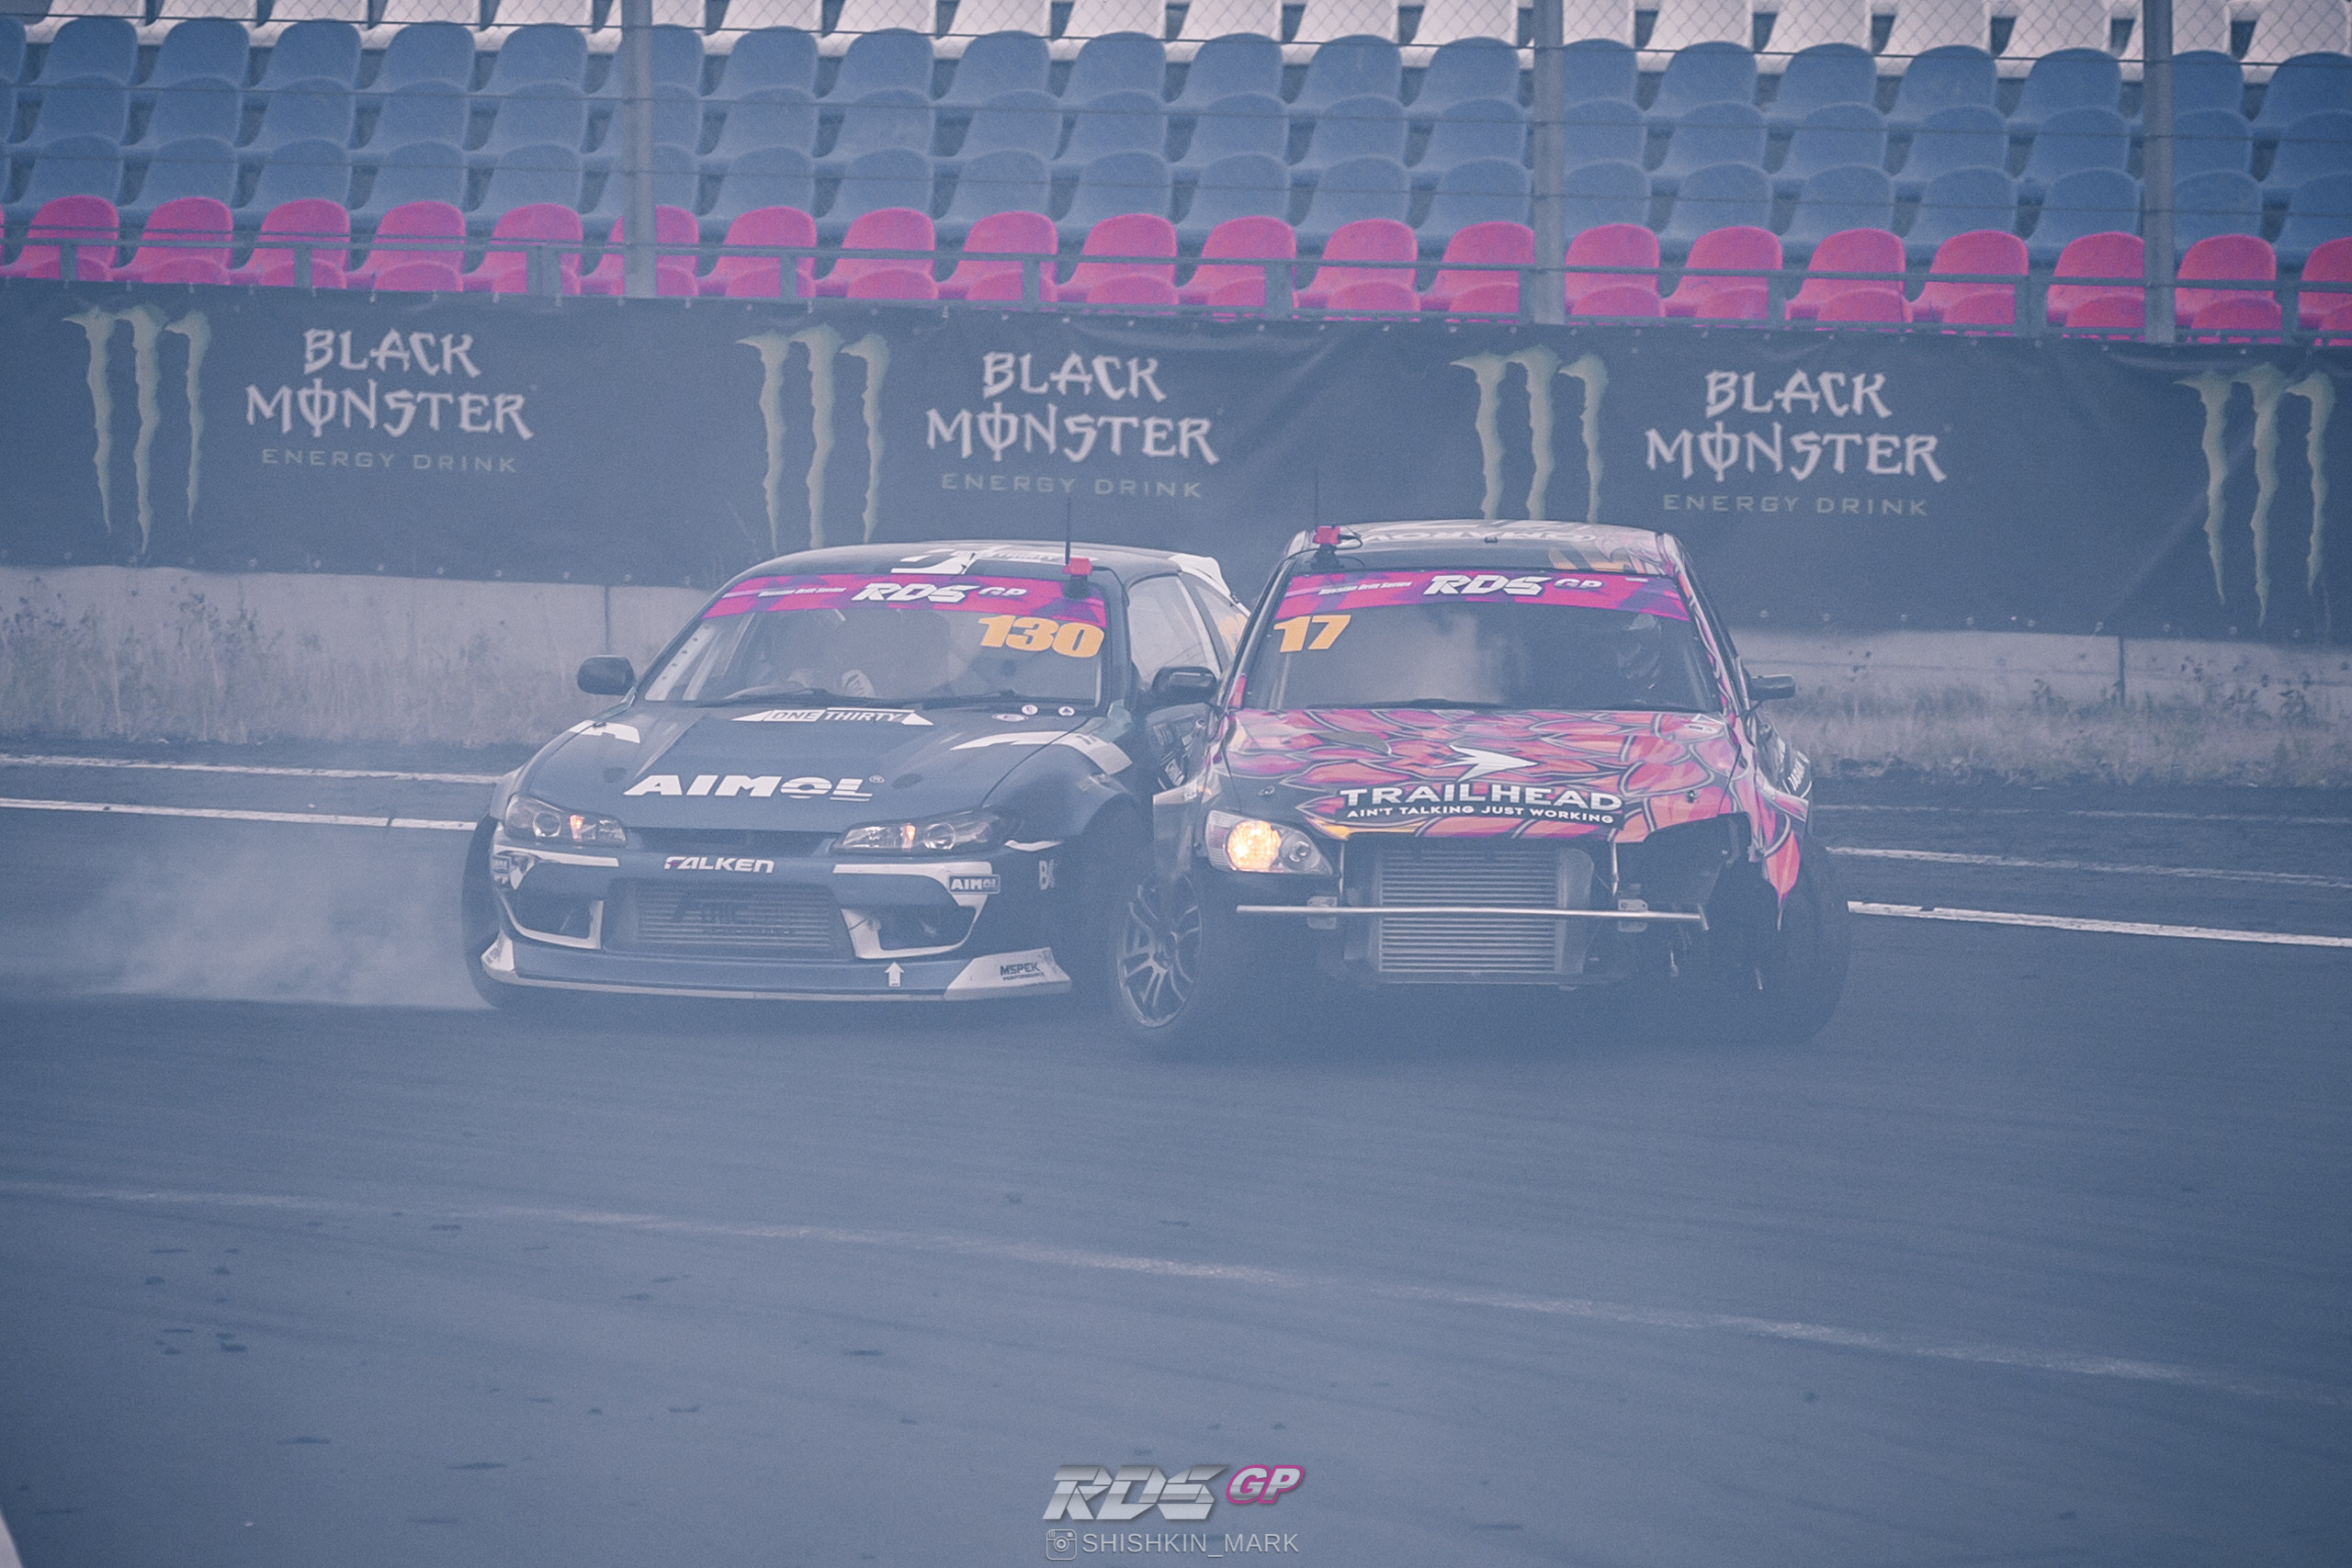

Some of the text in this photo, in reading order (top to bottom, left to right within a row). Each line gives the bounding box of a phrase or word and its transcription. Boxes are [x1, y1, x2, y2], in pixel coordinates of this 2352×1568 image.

[303, 328, 481, 377] BLACK
[983, 353, 1166, 401] BLACK
[1705, 369, 1892, 417] BLACK
[245, 378, 533, 439] MONSTER
[926, 402, 1219, 464] MONSTER
[262, 448, 517, 474] ENERGY DRINK
[1645, 422, 1946, 482] MONSTER
[942, 473, 1202, 499] ENERGY DRINK
[1663, 493, 1928, 516] ENERGY DRINK
[851, 582, 979, 604] RDS
[978, 586, 1028, 597] GP
[1423, 574, 1553, 596] RDS
[1553, 578, 1602, 590] GP
[978, 615, 1105, 658] 130
[1273, 615, 1351, 653] 17
[769, 710, 904, 722] ONE THIRTY
[623, 774, 873, 802] AIMOL
[1340, 783, 1623, 811] TRAILHEAD
[1347, 805, 1614, 825] AIN'T TALKING JUST WORKING
[663, 856, 775, 874] FALKEN
[1000, 962, 1041, 976] MSPEK
